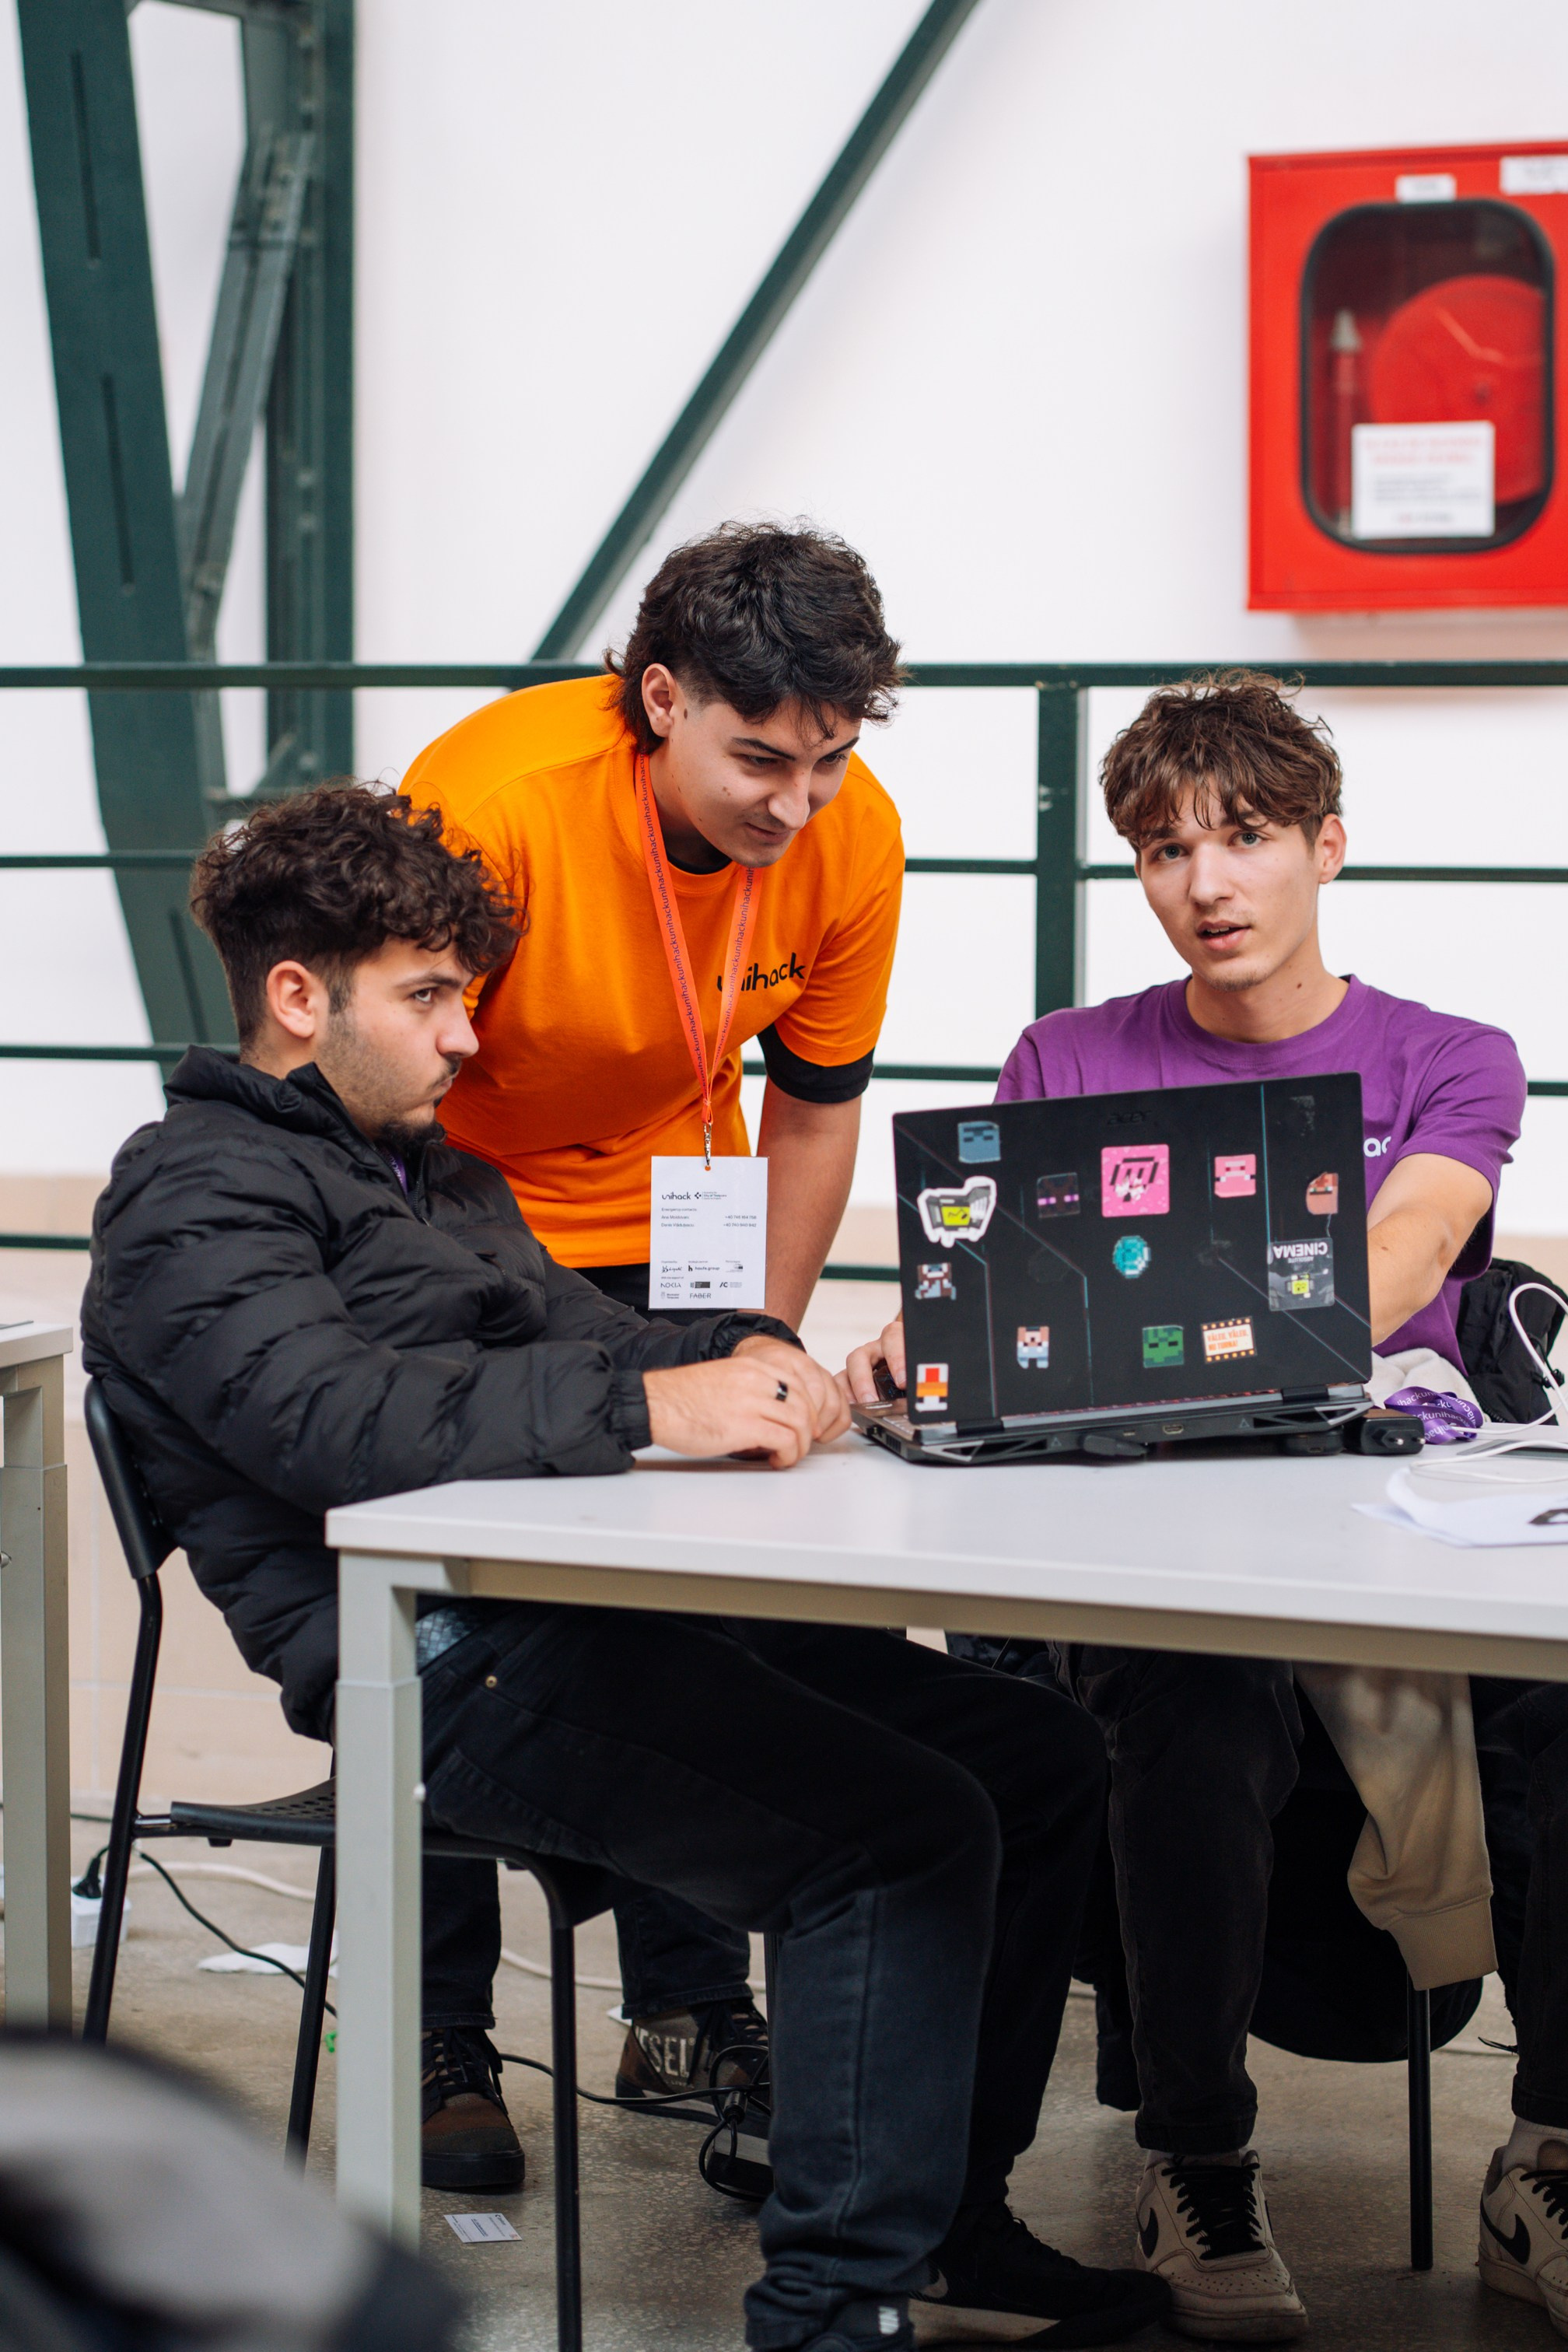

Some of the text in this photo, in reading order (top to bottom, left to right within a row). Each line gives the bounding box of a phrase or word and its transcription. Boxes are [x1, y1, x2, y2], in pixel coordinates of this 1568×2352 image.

[717, 952, 806, 992] uihack
[662, 1192, 691, 1200] unihack
[1272, 1241, 1328, 1259] CINEMA
